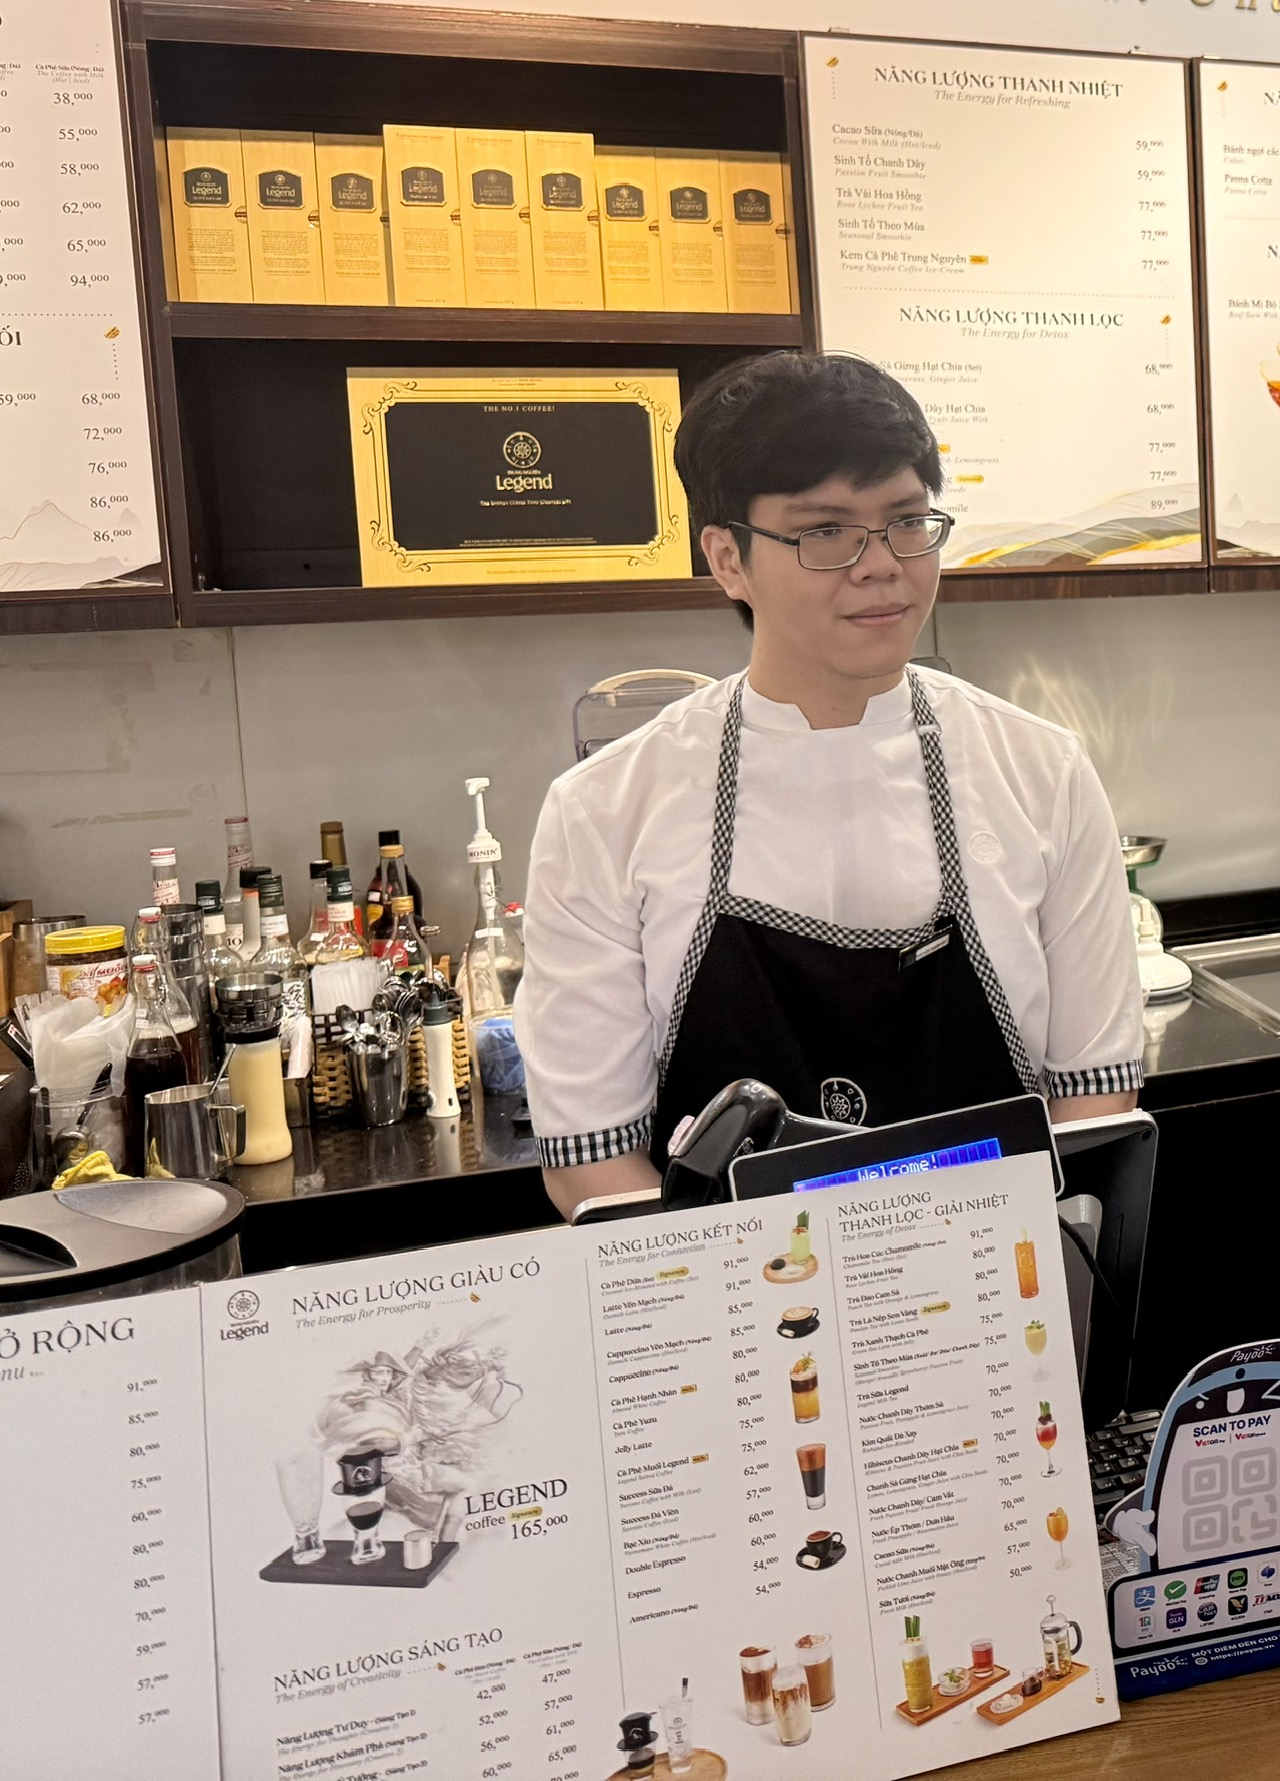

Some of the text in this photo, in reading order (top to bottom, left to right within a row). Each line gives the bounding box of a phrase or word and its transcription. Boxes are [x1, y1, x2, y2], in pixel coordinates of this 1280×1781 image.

[875, 66, 1122, 99] NĂNG LƯỢNG THANH NHIỆT
[53, 93, 92, 105] 38,000
[934, 89, 1070, 109] The Energy for Refreshing
[58, 129, 97, 141] 55,000
[60, 164, 99, 176] 58,000
[900, 305, 1122, 328] NĂNG LƯỢNG THANH LỌC
[961, 325, 1068, 340] The Energy for Detox
[483, 405, 499, 413] THE
[84, 427, 122, 441] 72,000
[496, 472, 552, 493] Legend
[467, 849, 501, 862] MONIN
[857, 1154, 939, 1182] Welcome!
[838, 1191, 931, 1217] NĂNG LƯỢNG
[839, 1194, 1008, 1233] THANH LỌC GIẢI NHIỆT
[599, 1217, 762, 1257] NĂNG LƯỢNG KẾT NỐI
[841, 1222, 916, 1243] The Energy of Detox
[598, 1244, 705, 1268] The Energy for Connection
[723, 1257, 749, 1269] 91,000
[293, 1256, 540, 1314] NĂNG LƯỢNG GIÀU CÓ
[602, 1304, 623, 1313] Latte
[637, 1296, 658, 1307] Mạch
[728, 1301, 753, 1314] 85,000
[295, 1299, 431, 1329] The Energy for Prosperity
[33, 1318, 133, 1354] RỘNG
[221, 1321, 268, 1341] Legend
[606, 1347, 649, 1358] Cappuccino
[664, 1339, 685, 1349] Mạch
[1229, 1346, 1264, 1362] Payoo
[127, 1379, 157, 1392] 91,000
[737, 1393, 762, 1407] 80,000
[1193, 1414, 1271, 1438] SCAN TO PAY
[614, 1441, 653, 1455] Jelly Latte
[131, 1476, 161, 1489] 75,000
[465, 1478, 567, 1515] LEGEND
[132, 1509, 161, 1522] 60,000
[466, 1508, 540, 1531] coffee Signature
[512, 1514, 568, 1539] 165,000
[625, 1556, 686, 1574] Double Espresso
[627, 1588, 661, 1599] Espresso
[630, 1610, 670, 1624] Americano
[1191, 1649, 1212, 1658] MỘT
[1257, 1635, 1279, 1645] CHO
[1210, 1644, 1274, 1661] https://payoo.vn
[275, 1628, 502, 1692] NĂNG LƯỢNG SÁNG TẠO
[1130, 1659, 1177, 1678] Payoo
[542, 1668, 570, 1683] 47,000
[275, 1669, 401, 1704] The Energy of Creativity
[545, 1694, 572, 1711] 57,000
[546, 1719, 574, 1736] 61,000
